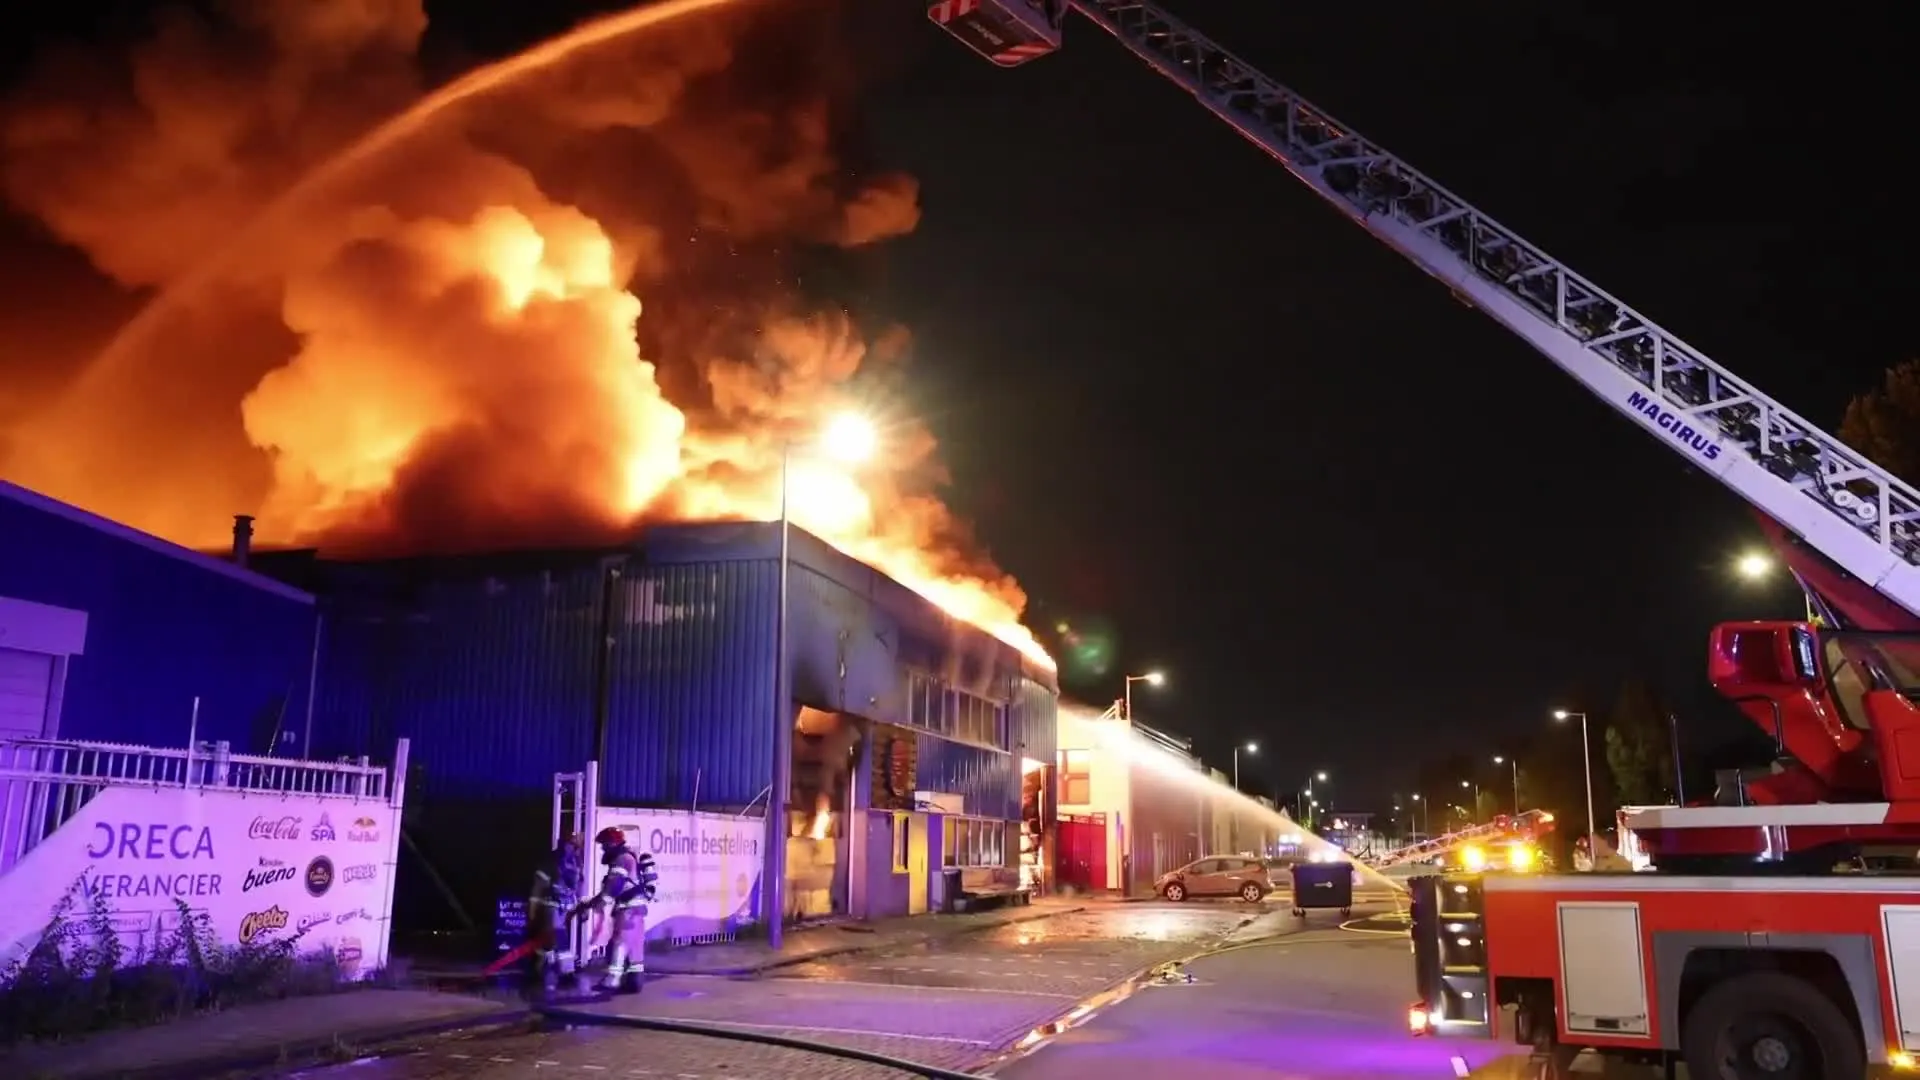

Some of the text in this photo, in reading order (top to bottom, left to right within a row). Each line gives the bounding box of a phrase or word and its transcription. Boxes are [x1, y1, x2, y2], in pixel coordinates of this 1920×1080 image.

[1627, 391, 1721, 460] MAGIRUS
[88, 822, 215, 860] ORECA
[310, 829, 336, 841] SPA
[650, 828, 758, 856] Online bestellen
[81, 873, 222, 899] VERANCIER
[242, 866, 297, 892] bueno
[239, 904, 289, 945] Cheetos
